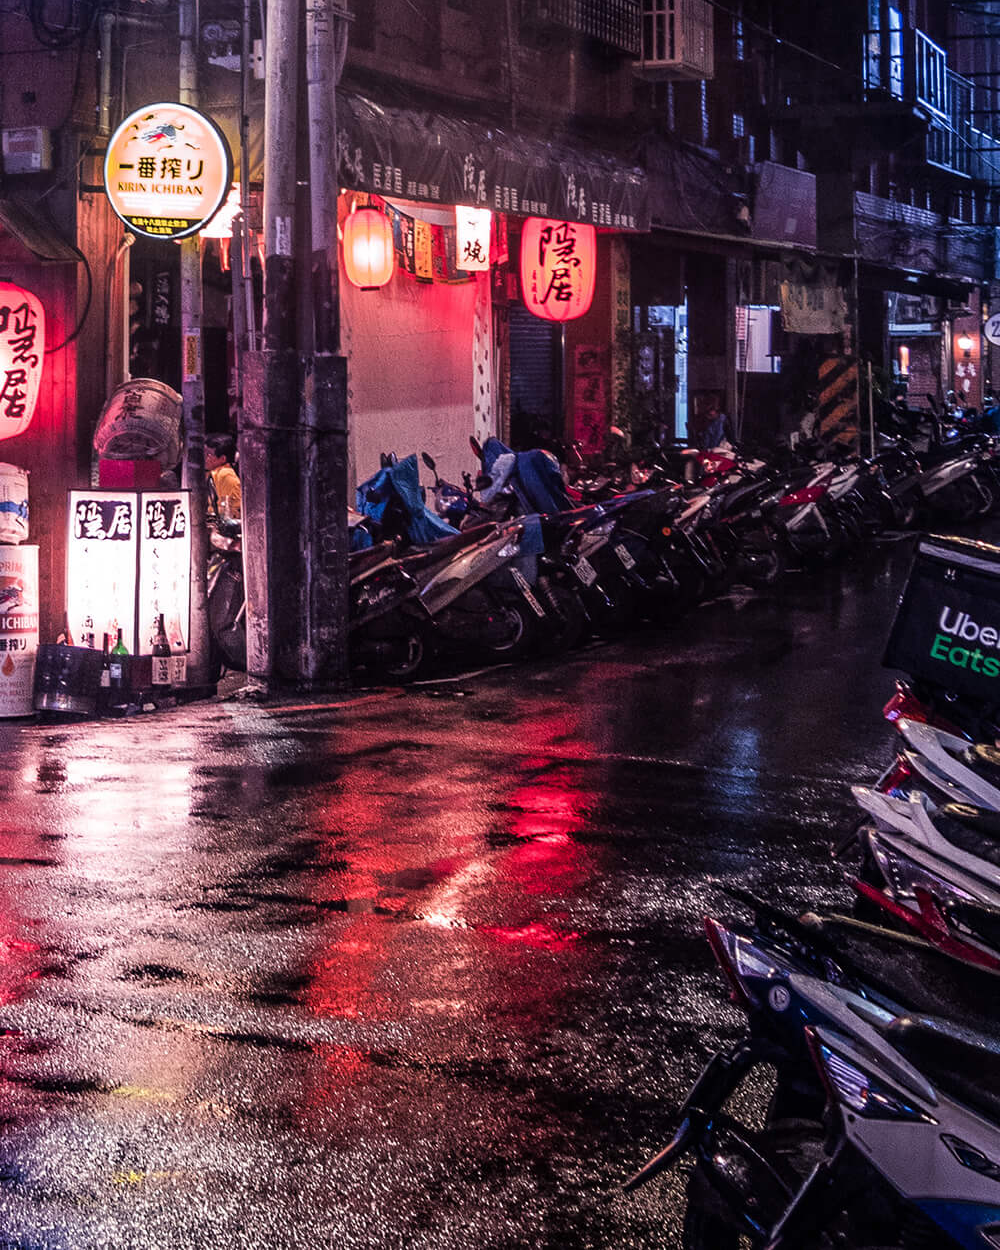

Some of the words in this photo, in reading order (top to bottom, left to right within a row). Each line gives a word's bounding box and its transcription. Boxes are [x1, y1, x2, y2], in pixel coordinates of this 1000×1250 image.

[118, 156, 204, 180] 一番搾り
[117, 181, 147, 192] KIRIN
[151, 182, 204, 195] ICHIBAN
[538, 222, 581, 305] 隱居
[75, 501, 132, 539] 隱居
[146, 502, 185, 539] 隱居
[930, 633, 1000, 678] Eats
